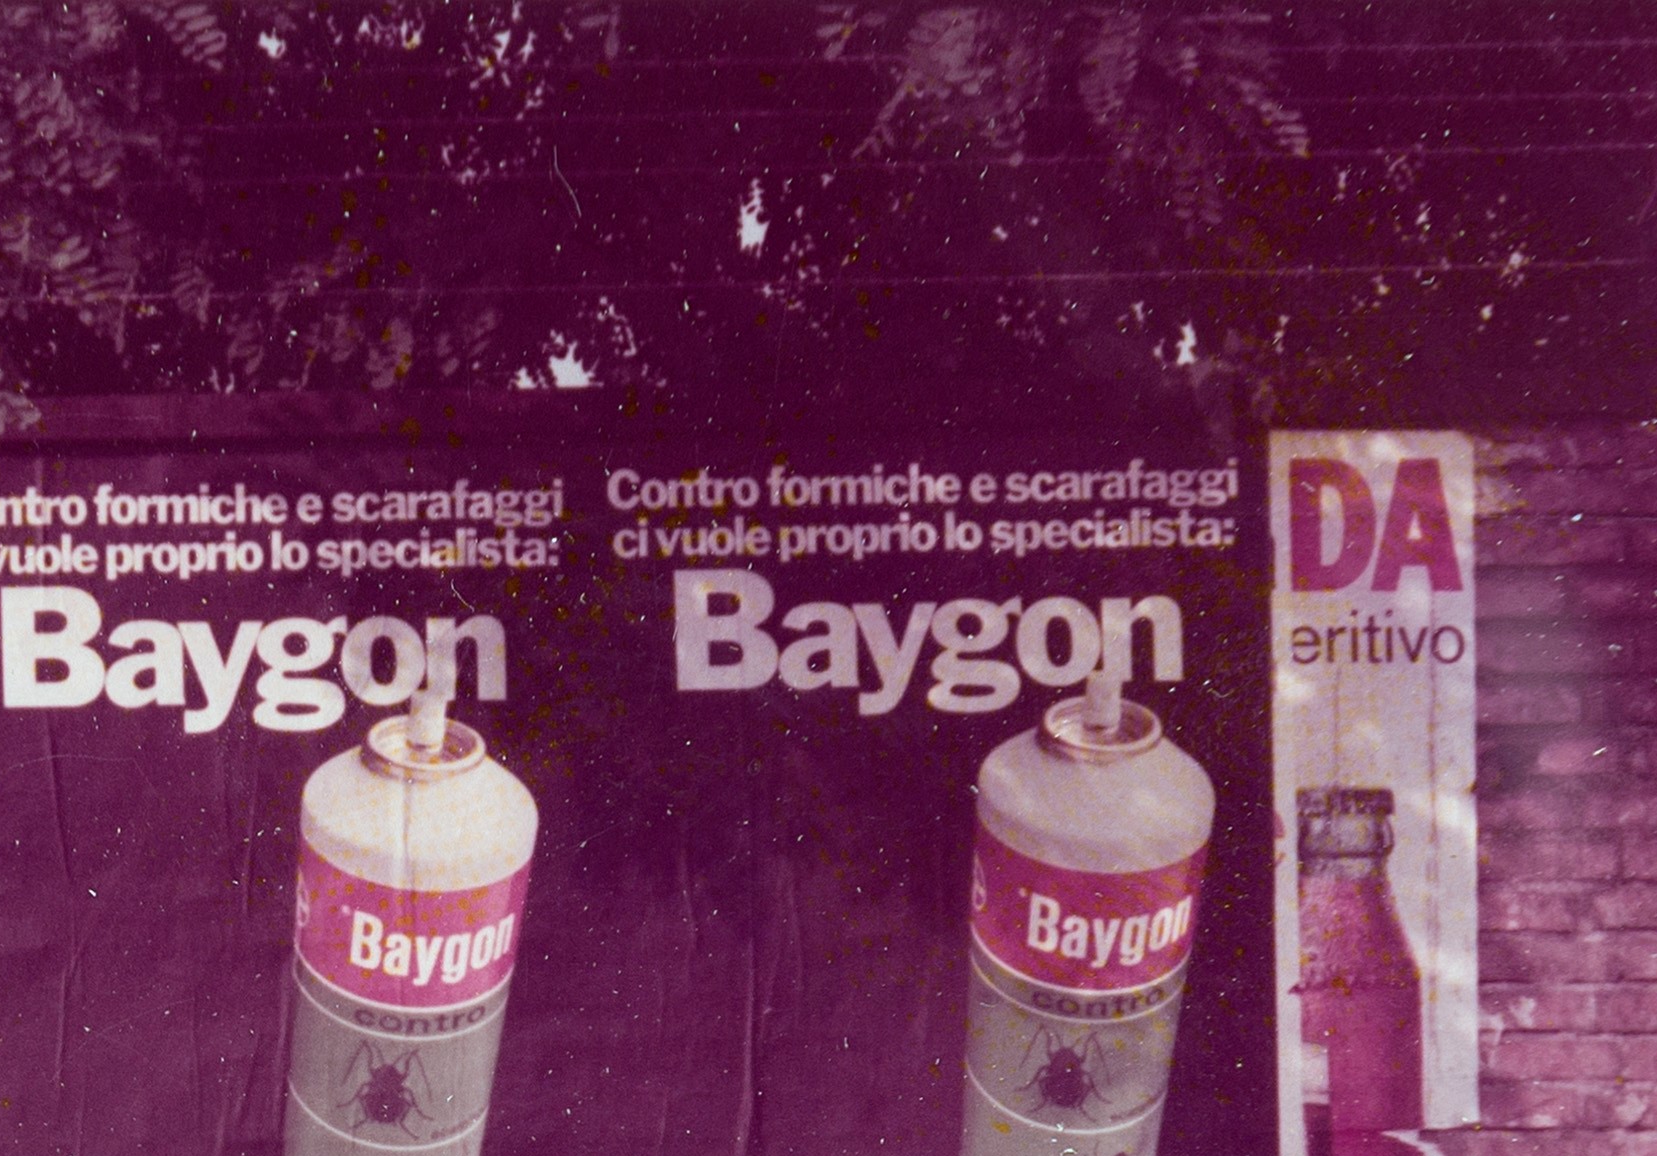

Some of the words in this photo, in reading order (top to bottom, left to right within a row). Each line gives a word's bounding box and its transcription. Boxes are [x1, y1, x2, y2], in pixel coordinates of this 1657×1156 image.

[93, 482, 287, 525] formiche
[295, 493, 323, 524] e
[331, 478, 564, 528] scarafaggi
[605, 466, 760, 512] Contro
[765, 463, 962, 508] formiche
[970, 474, 998, 505] e
[1003, 457, 1239, 508] scarafaggi
[611, 519, 650, 560] ci
[656, 515, 771, 557] vuole
[778, 512, 937, 562] proprio
[942, 510, 983, 553] lo
[989, 506, 1236, 557] specialista:
[1289, 457, 1464, 592] DA
[105, 531, 264, 581] proprio
[270, 530, 309, 572] lo
[315, 527, 561, 579] specialista:
[0, 586, 507, 734] Baygon
[672, 567, 1183, 716] Baygon
[1292, 609, 1465, 664] eritivo
[350, 910, 515, 986] Baygon
[1028, 892, 1192, 968] Baygon
[354, 1006, 485, 1034] contro
[1032, 988, 1165, 1017] contro
